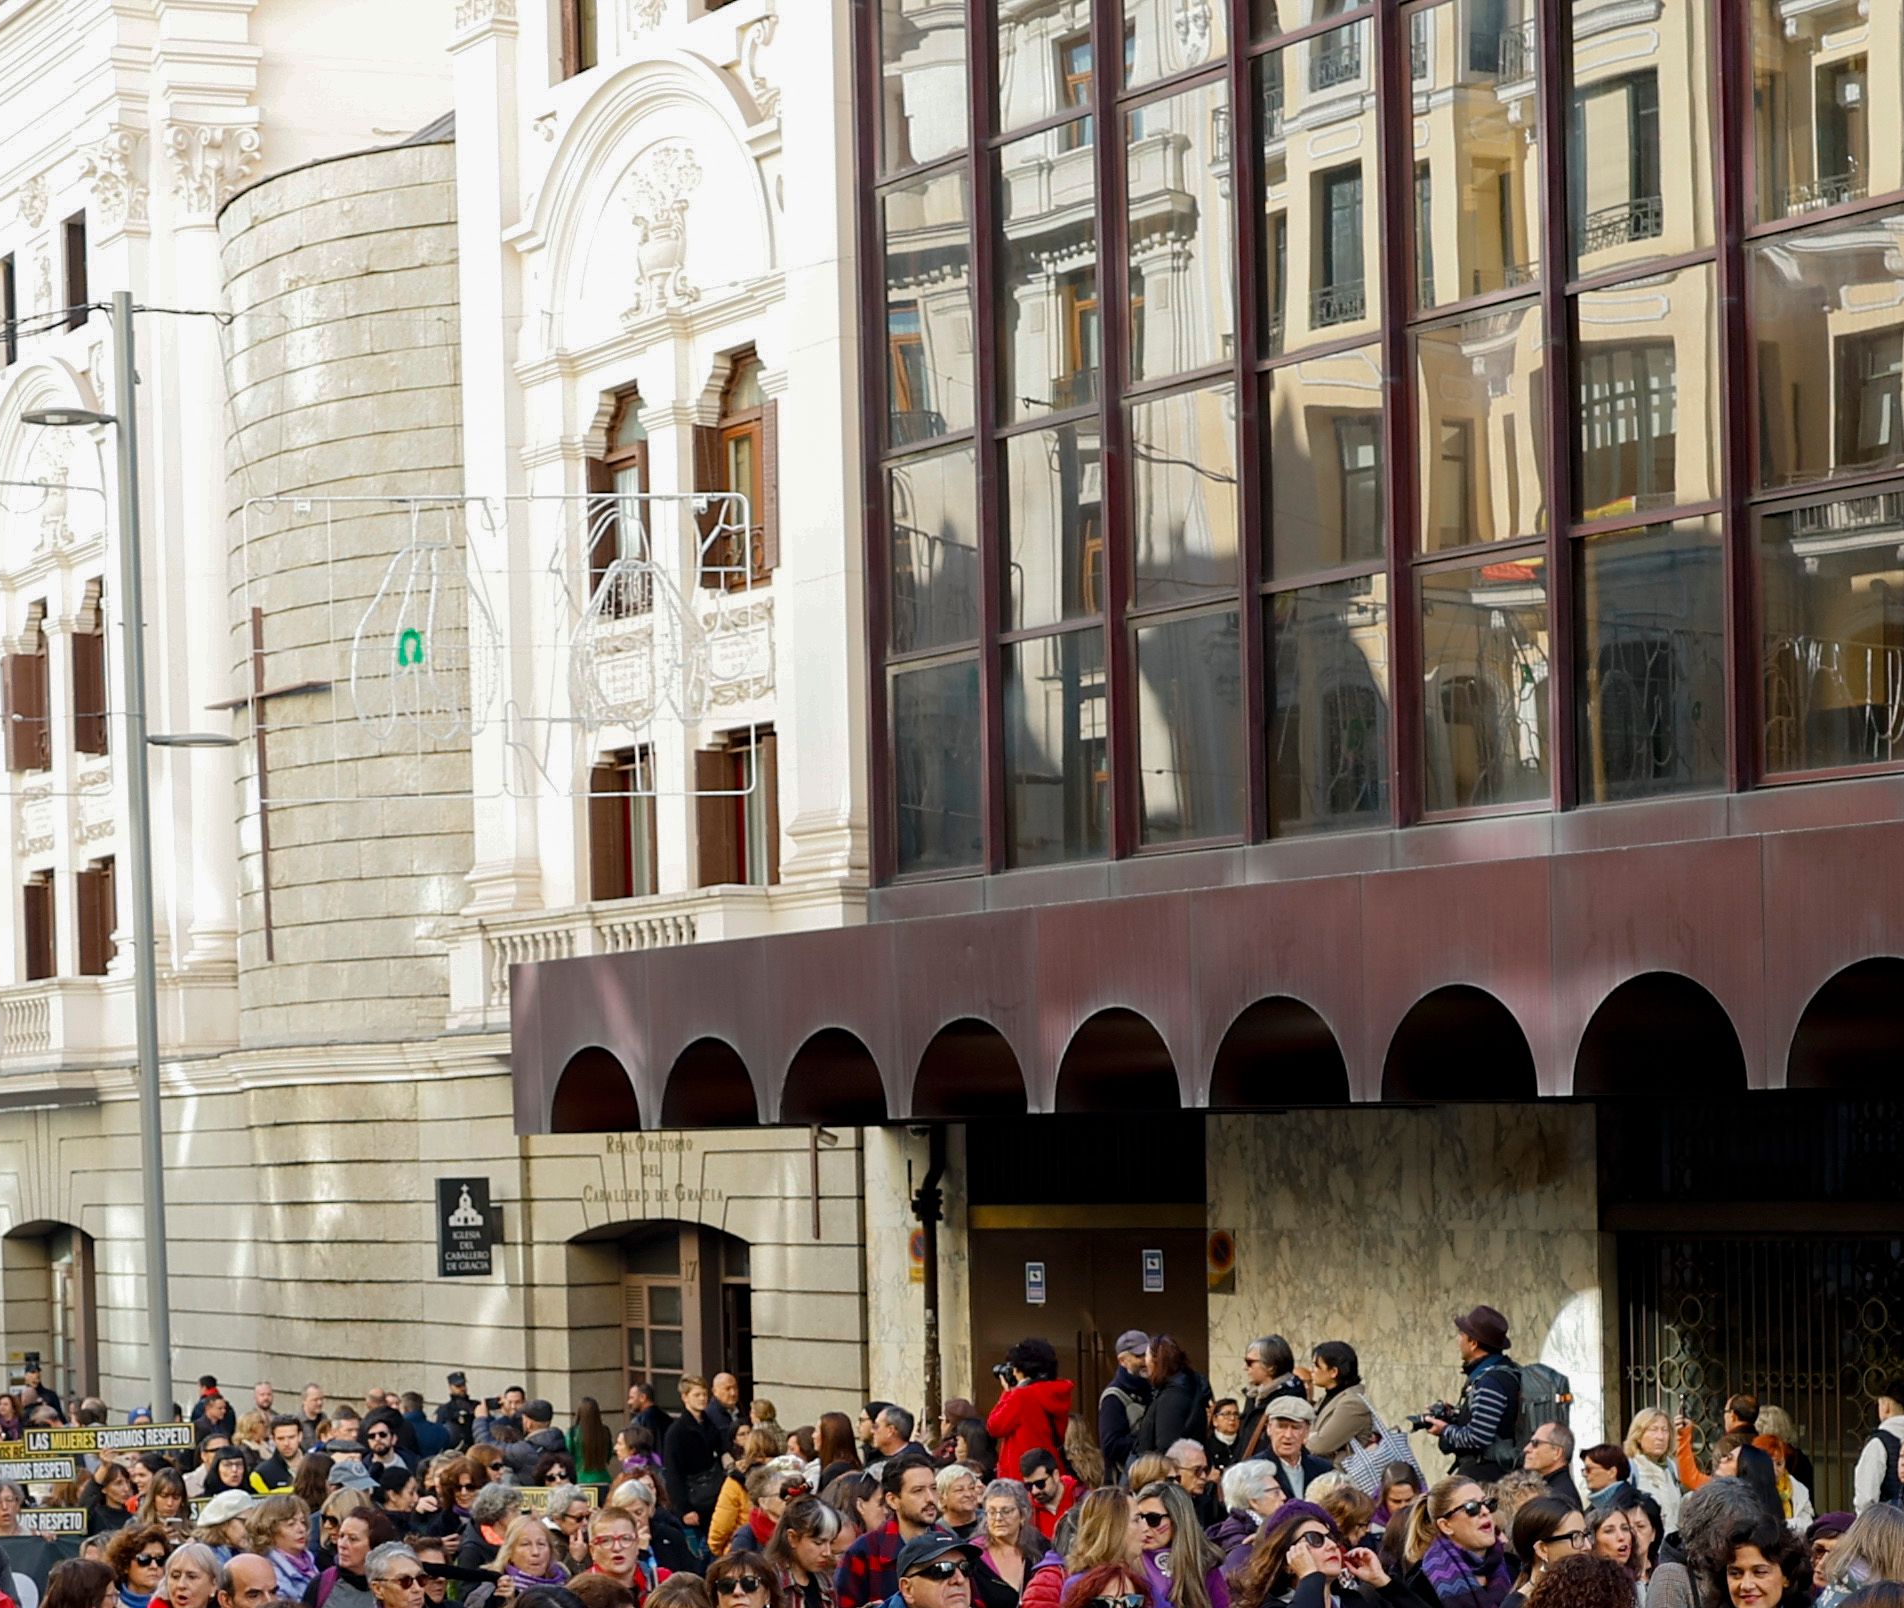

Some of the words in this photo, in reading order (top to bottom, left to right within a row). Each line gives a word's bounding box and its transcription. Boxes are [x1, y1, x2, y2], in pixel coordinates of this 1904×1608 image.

[452, 1231, 481, 1239] IGLESIA
[459, 1241, 474, 1250] DEL
[445, 1251, 489, 1260] CABALLERO
[446, 1262, 457, 1271] DE
[458, 1261, 489, 1270] GRACIA
[29, 1434, 50, 1450] LAS
[51, 1432, 96, 1449] MUJERES
[97, 1430, 145, 1448] EXIGIMOS
[145, 1427, 190, 1445] RESPETO
[33, 1461, 72, 1479] RESPETO
[39, 1512, 82, 1530] RESPETO
